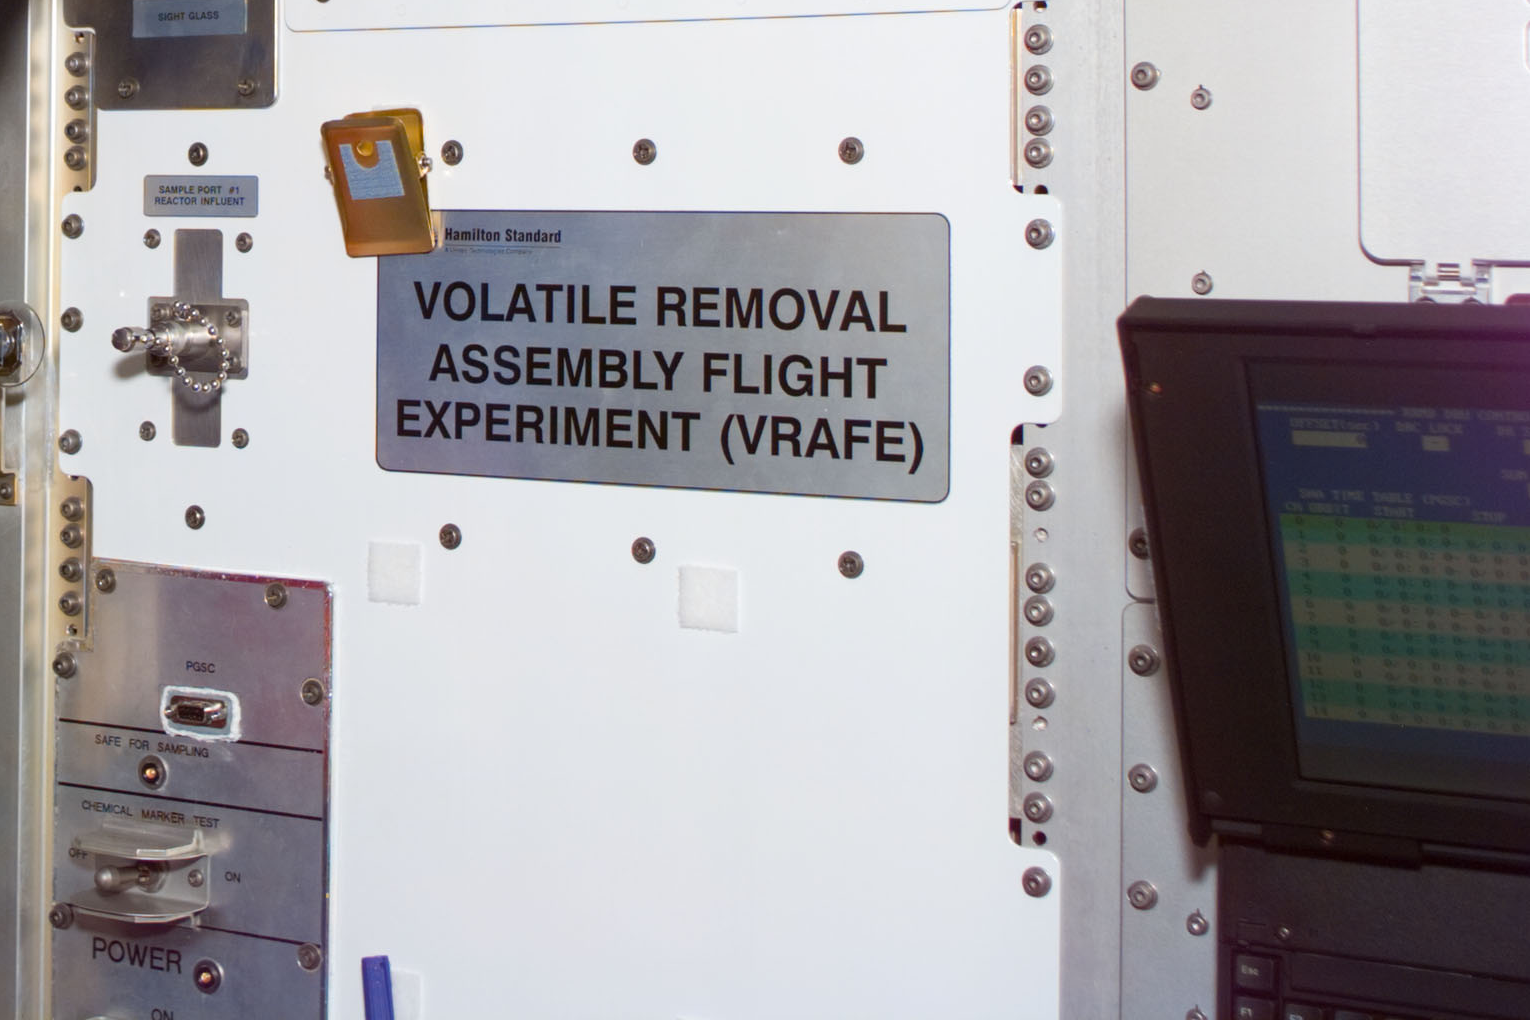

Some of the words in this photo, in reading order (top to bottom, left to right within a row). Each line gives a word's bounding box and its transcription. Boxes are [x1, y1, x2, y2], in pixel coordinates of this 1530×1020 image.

[158, 12, 185, 22] SIGHT
[188, 10, 219, 21] GLASS
[158, 185, 194, 195] SAMPLE
[197, 185, 222, 195] PORT
[229, 186, 240, 195] #1
[154, 196, 197, 206] REACTOR
[200, 197, 245, 207] INFLUENT
[445, 227, 501, 242] Hamilton
[505, 228, 562, 244] Standard
[413, 280, 638, 327] VOLATILE
[656, 285, 908, 334] REMOVAL
[427, 343, 685, 392] ASSEMBLY
[702, 351, 888, 399] FLIGHT
[396, 400, 702, 452] EXPERIMENT
[720, 412, 925, 476] (VRAFE)
[185, 660, 216, 674] PGSC
[94, 734, 122, 747] SAFE
[129, 738, 150, 751] FOR
[157, 741, 210, 758] SAMPLING
[81, 800, 134, 817] CHEMICAL
[141, 808, 186, 826] MARKER
[193, 816, 220, 829] TEST
[224, 871, 241, 884] ON
[92, 937, 183, 974] POWER
[151, 1008, 174, 1020] ON
